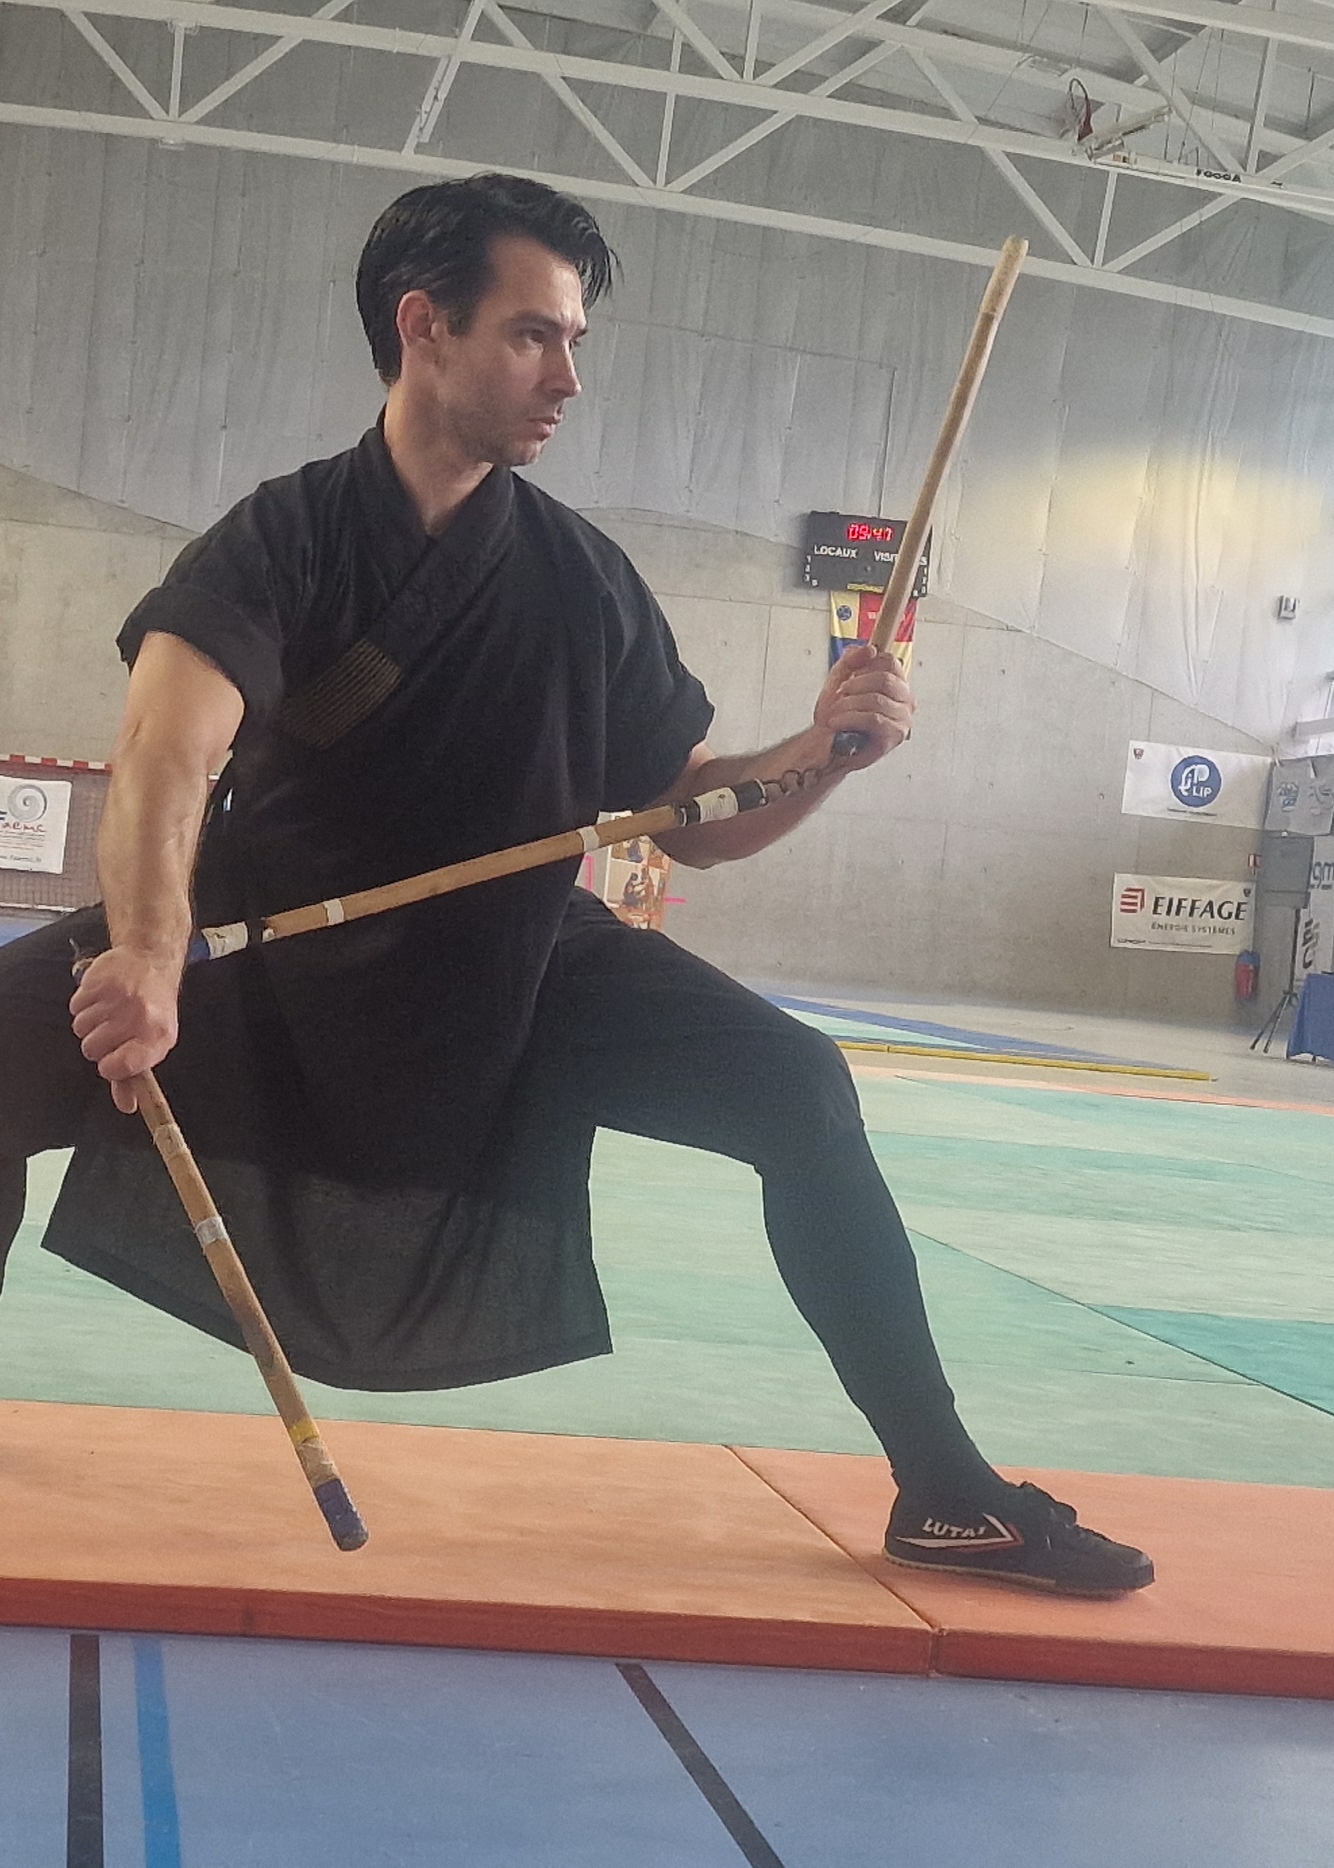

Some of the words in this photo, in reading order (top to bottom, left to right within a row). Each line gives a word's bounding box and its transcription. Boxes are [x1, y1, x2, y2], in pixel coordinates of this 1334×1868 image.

[814, 544, 858, 558] LOCAUX
[1152, 896, 1248, 921] EIFFAGE
[922, 1517, 986, 1538] LUTAI
